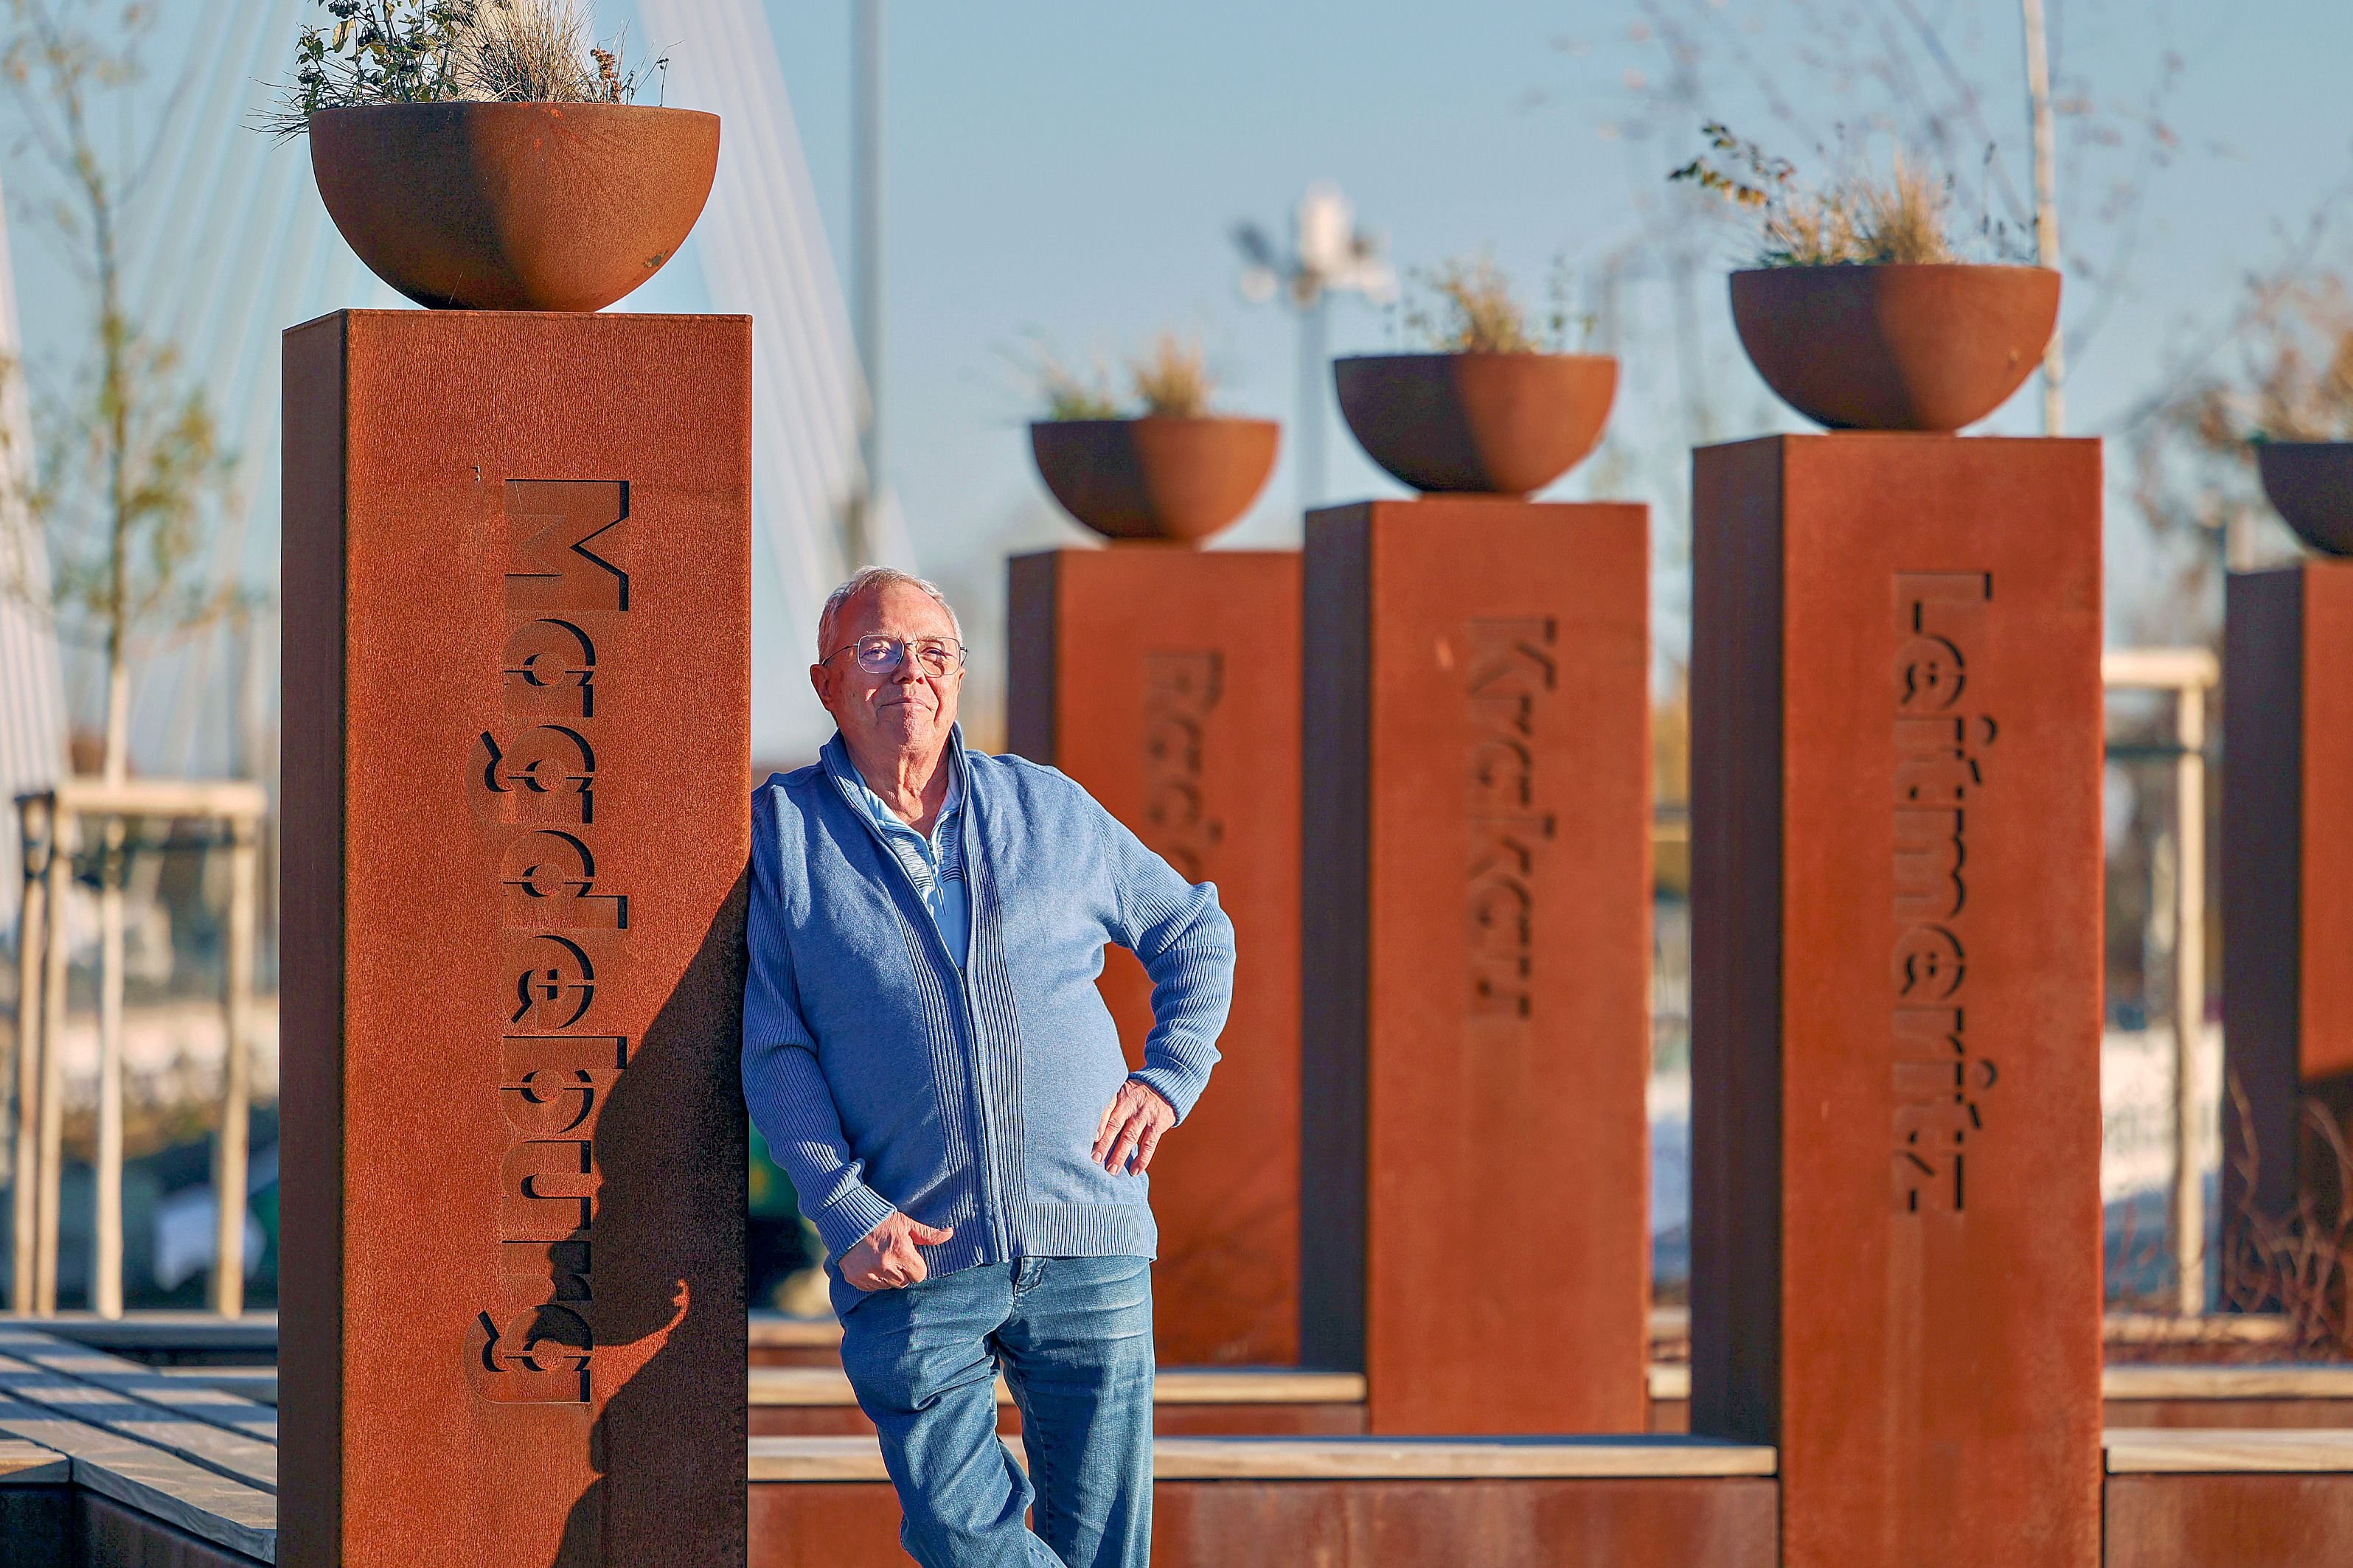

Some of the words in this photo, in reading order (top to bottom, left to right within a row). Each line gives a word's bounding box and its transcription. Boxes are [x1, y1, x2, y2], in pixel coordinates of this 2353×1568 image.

[466, 478, 631, 1410] Magdeburg
[1466, 616, 1559, 1021] Krakau
[1892, 571, 1998, 1215] Leitmeritz
